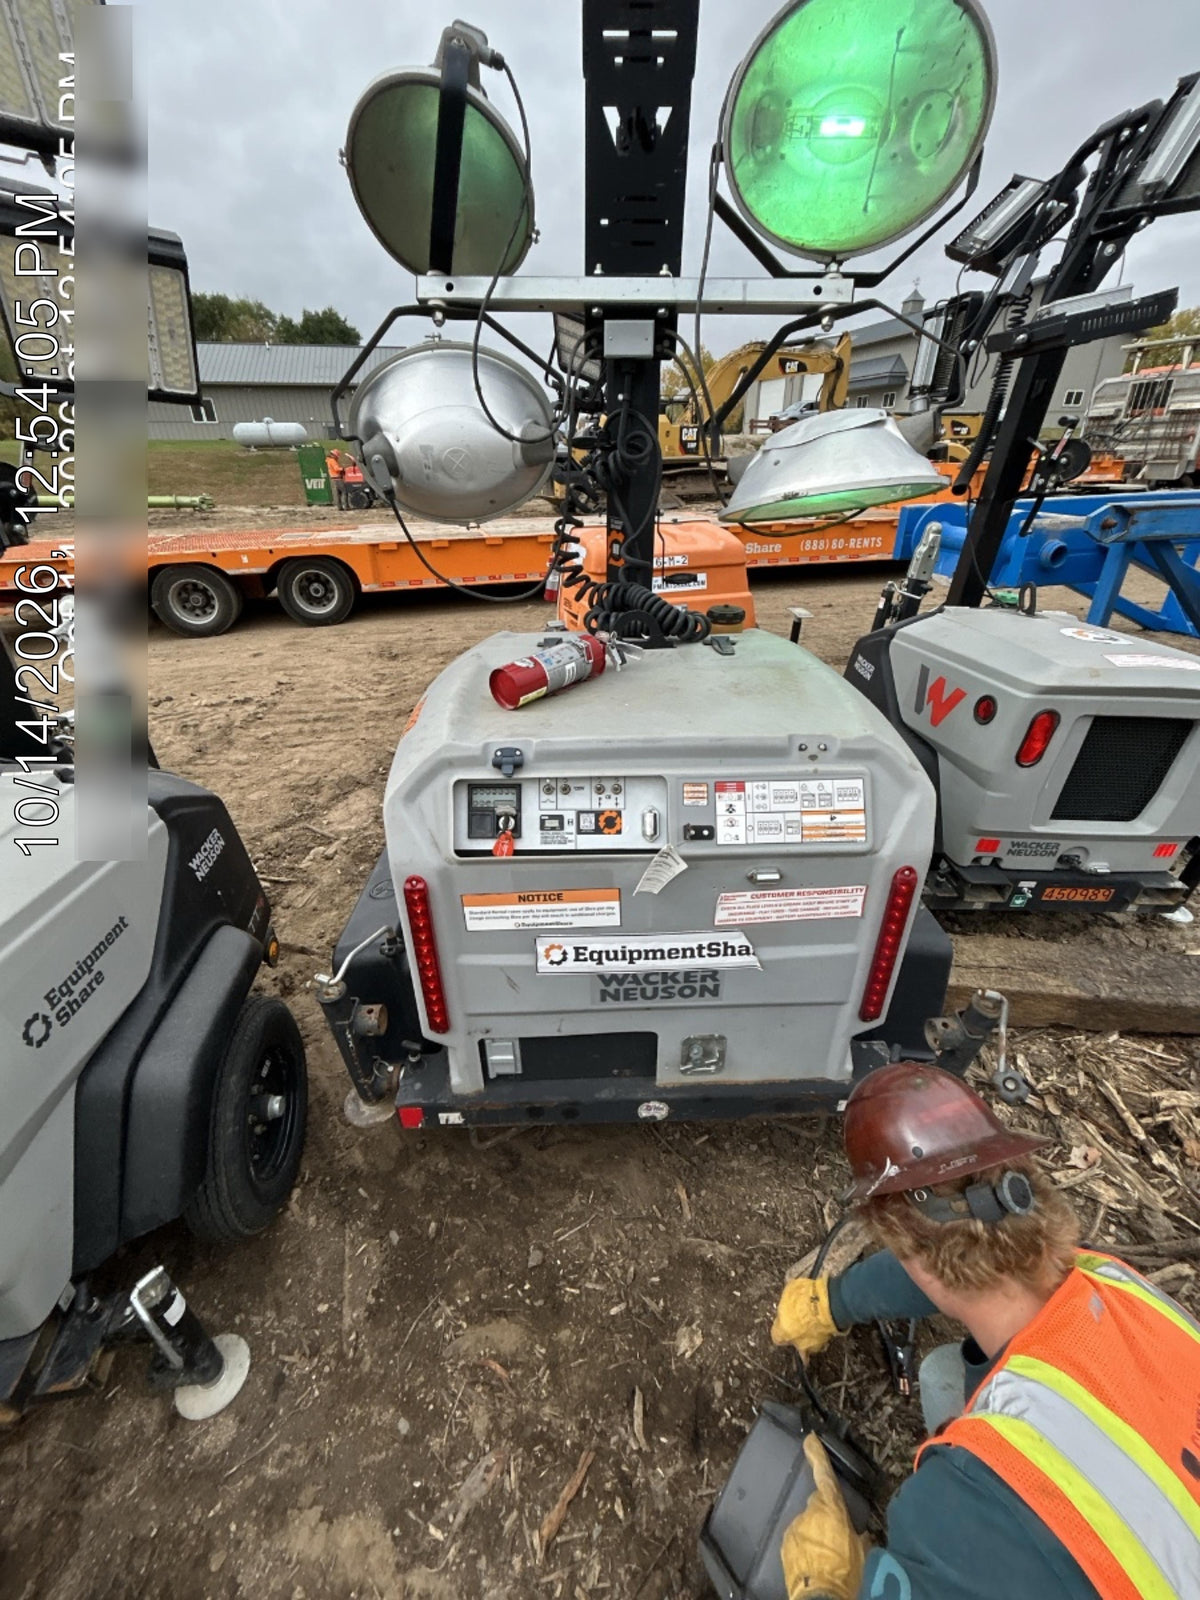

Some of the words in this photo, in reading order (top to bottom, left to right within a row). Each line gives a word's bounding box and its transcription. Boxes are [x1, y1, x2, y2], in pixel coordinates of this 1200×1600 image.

[786, 362, 798, 373] CAT
[682, 428, 698, 440] CAT
[745, 542, 782, 554] Share
[188, 828, 220, 870] WACKER
[1011, 841, 1061, 850] WACKER
[195, 837, 226, 882] NEUSON
[1007, 849, 1058, 857] NEUSON
[518, 893, 563, 903] NOTICE
[751, 891, 795, 900] CUSTOMER
[797, 887, 864, 897] RESPONSIBILITY
[1044, 888, 1112, 900] 450989
[573, 942, 756, 965] EquipmentSha
[43, 916, 129, 1011] Equipment
[597, 970, 720, 987] WACKER
[55, 970, 105, 1027] Share
[600, 984, 720, 1002] NEUSON
